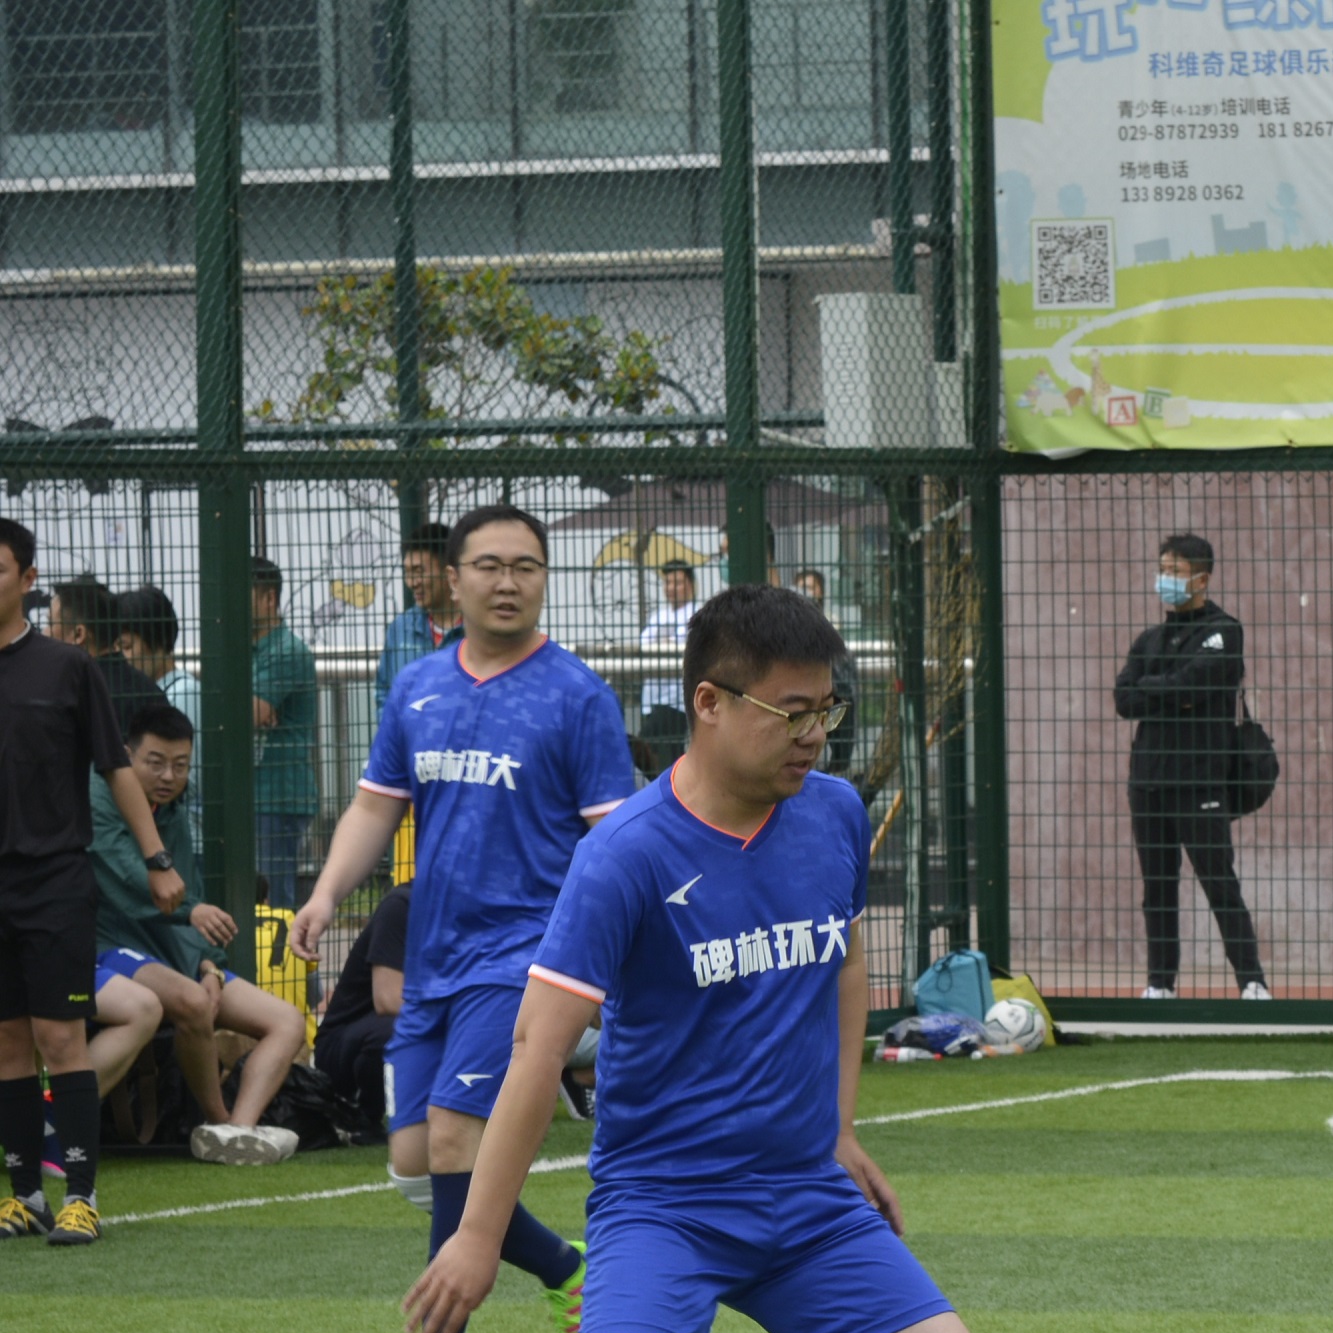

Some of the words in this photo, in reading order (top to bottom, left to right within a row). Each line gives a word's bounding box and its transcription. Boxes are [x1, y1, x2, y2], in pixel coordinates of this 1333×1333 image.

[1118, 124, 1240, 141] 029-87872939
[1257, 122, 1288, 138] 181
[1120, 160, 1189, 179] 场地电话
[1121, 187, 1149, 203] 133
[1153, 186, 1197, 201] 8928
[1202, 185, 1244, 201] 0362
[414, 749, 522, 791] 碑林环大
[690, 914, 847, 988] 碑林环大
